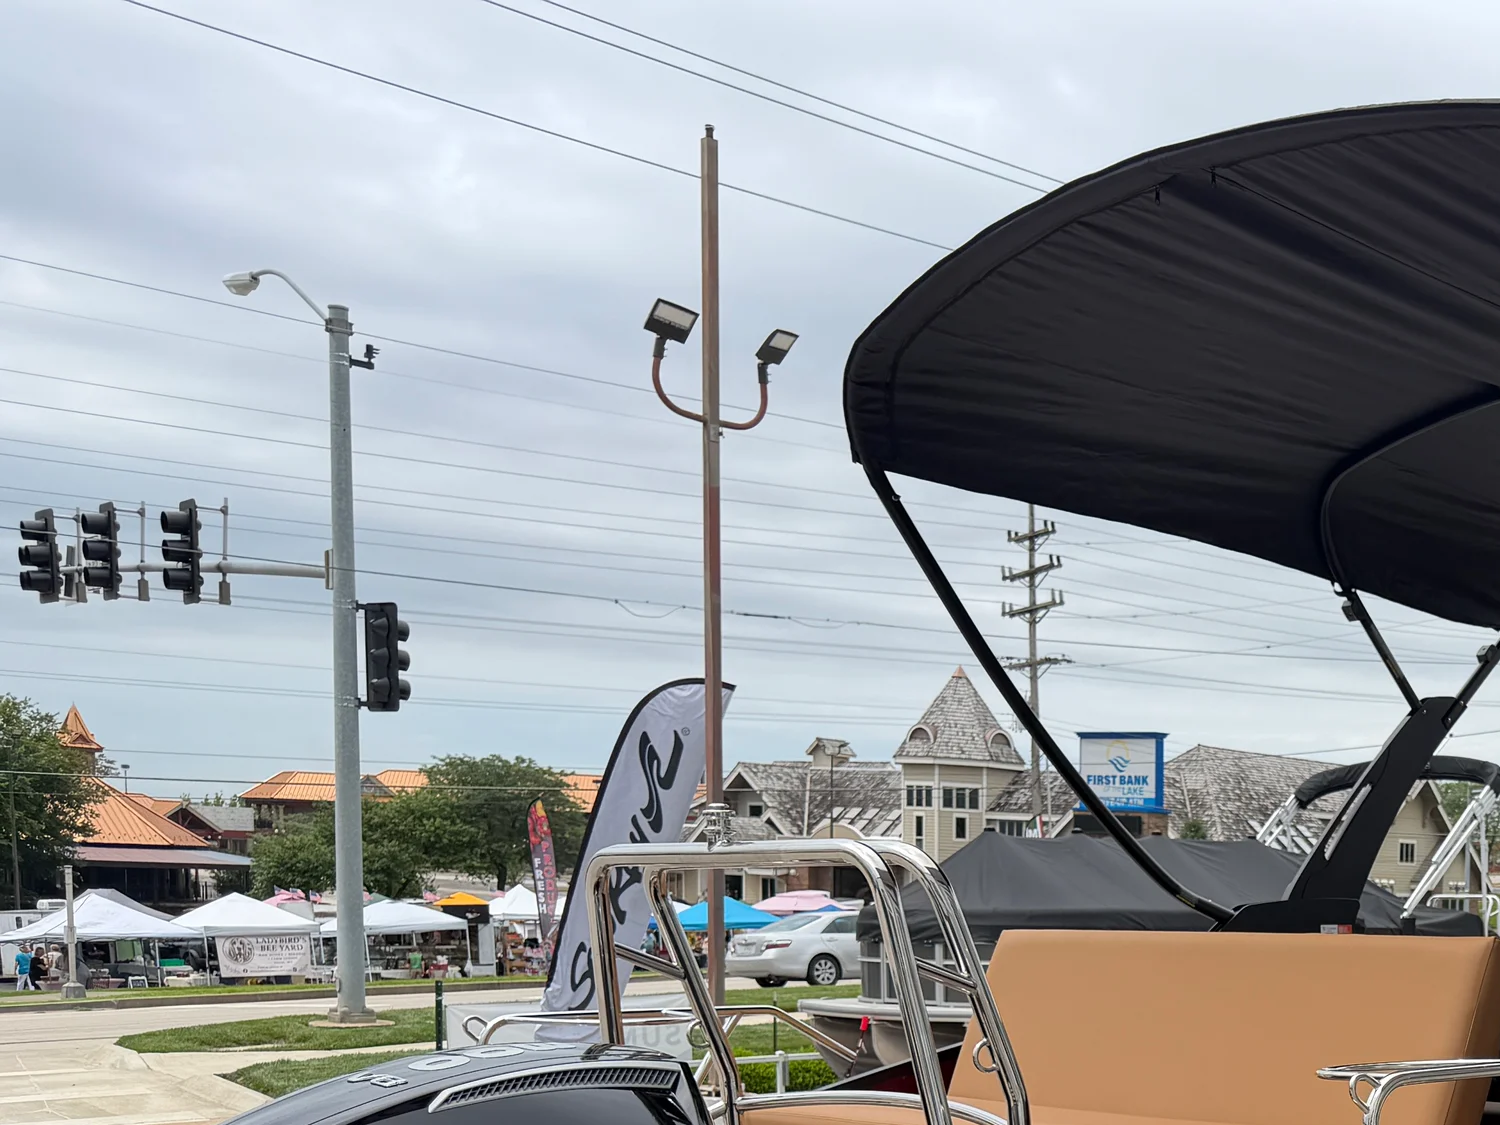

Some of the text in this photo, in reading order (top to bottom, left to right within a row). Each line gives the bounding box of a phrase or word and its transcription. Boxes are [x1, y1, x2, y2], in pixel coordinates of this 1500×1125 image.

[1087, 775, 1149, 785] FIRST BANK
[1122, 787, 1144, 796] LAKE
[534, 857, 547, 914] FRESH
[255, 936, 307, 944] LADYBIRD'S
[260, 943, 304, 952] BEE YARD
